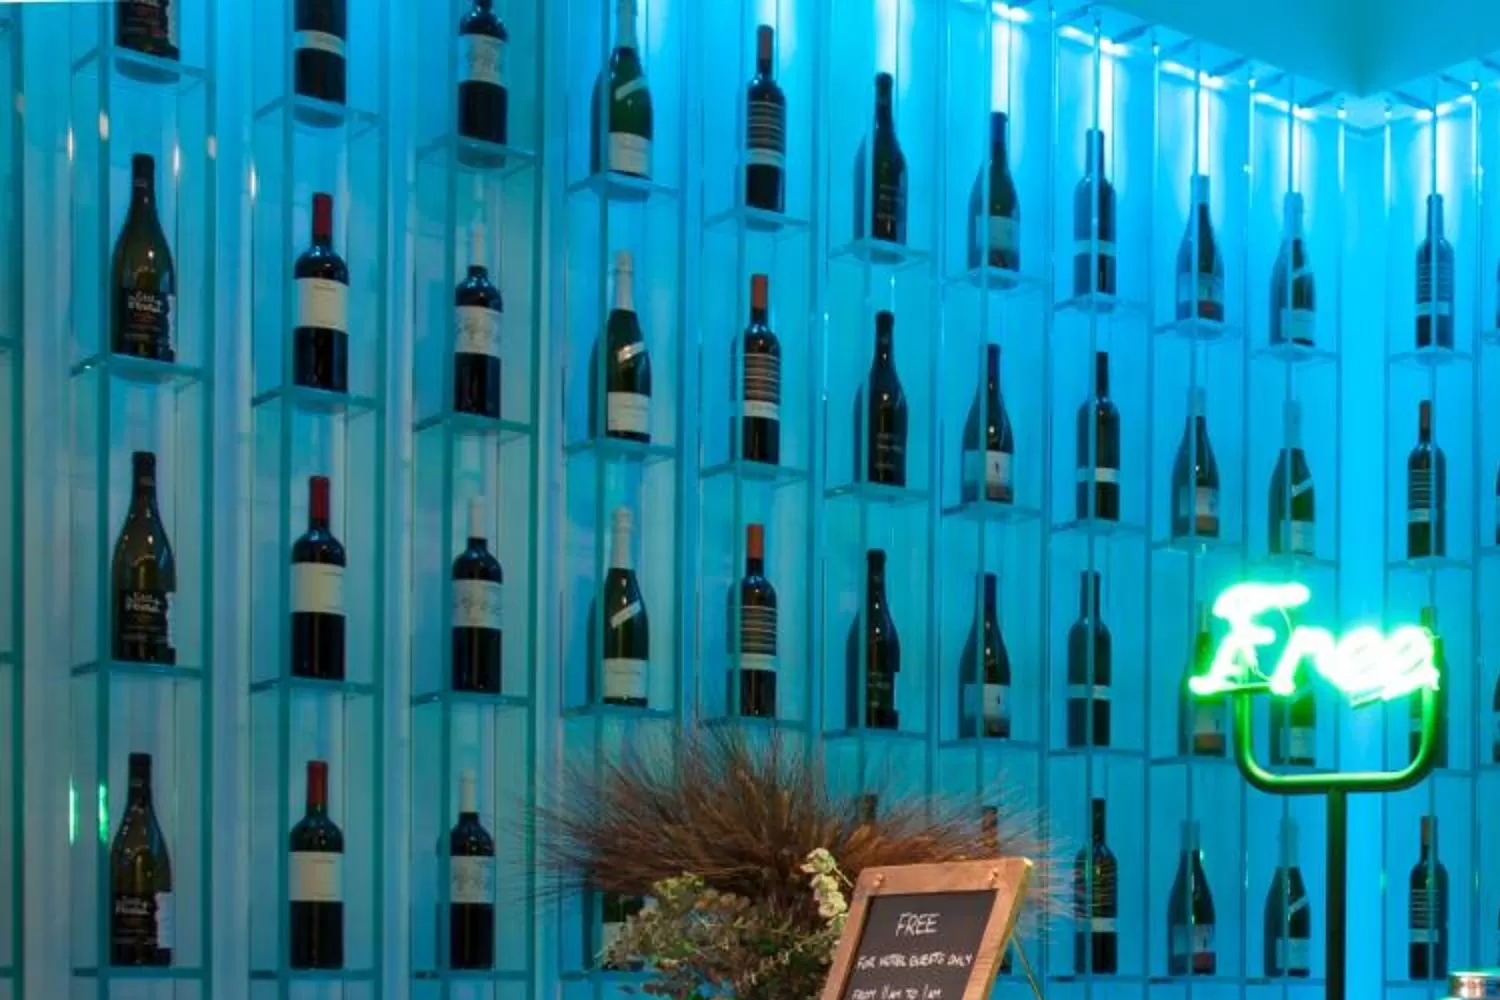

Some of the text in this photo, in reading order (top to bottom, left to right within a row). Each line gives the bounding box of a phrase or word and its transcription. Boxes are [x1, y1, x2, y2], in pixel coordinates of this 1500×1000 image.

[1188, 582, 1440, 704] Free
[895, 911, 941, 937] FREE
[857, 955, 877, 970] FOR
[879, 952, 907, 968] HOTEL
[947, 953, 973, 968] ONLY
[852, 987, 877, 1000] FROM
[905, 987, 919, 1000] TO
